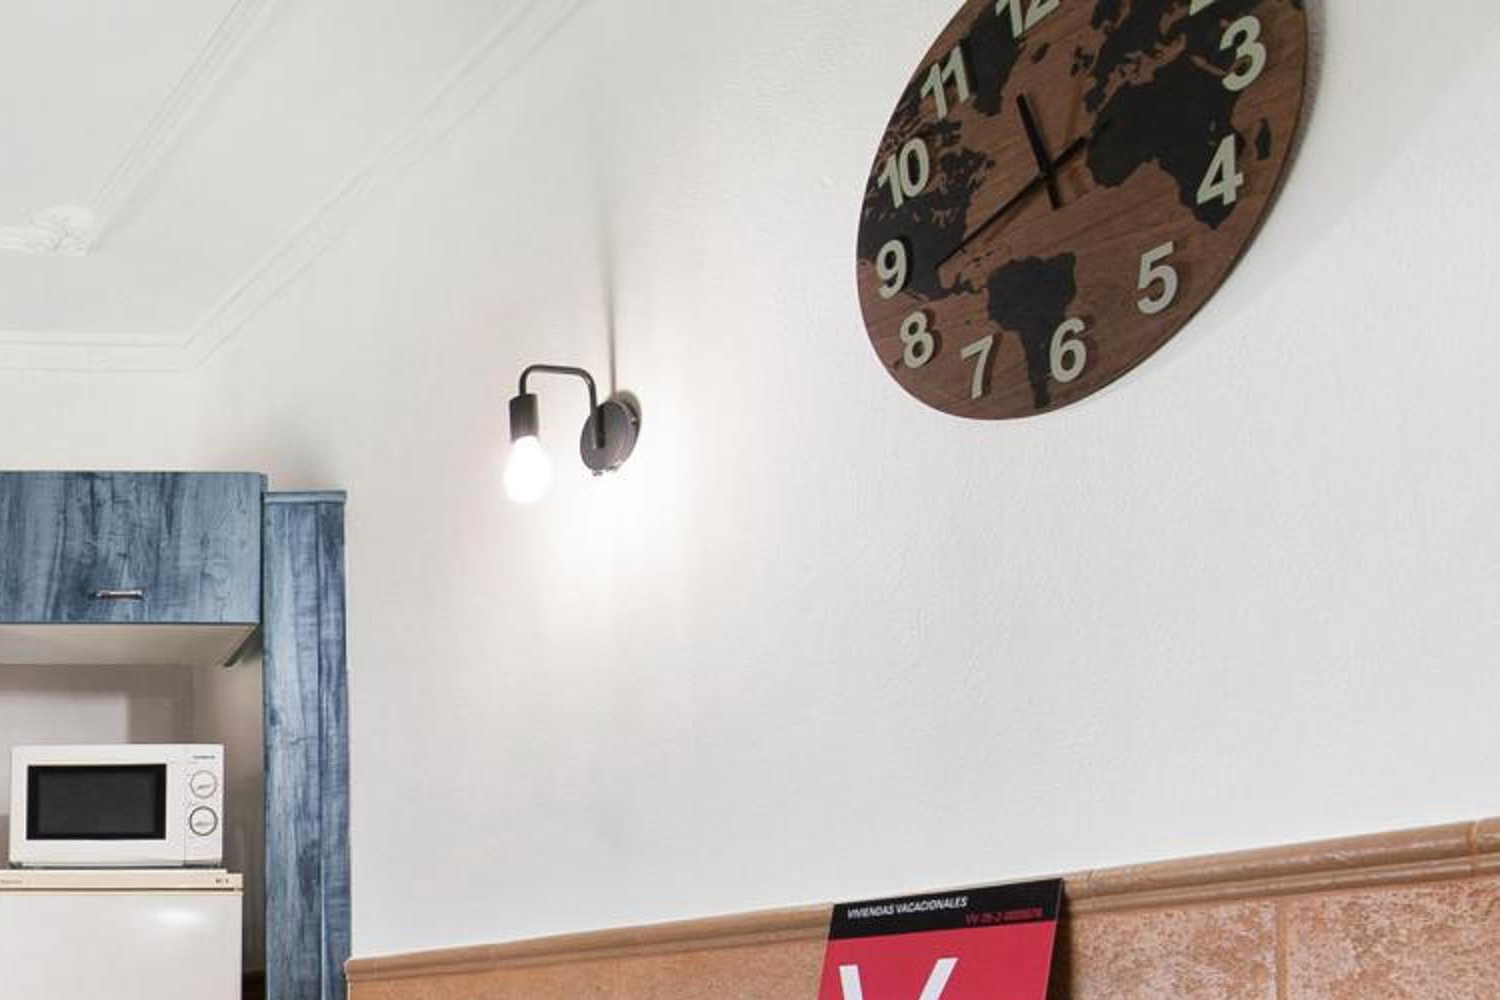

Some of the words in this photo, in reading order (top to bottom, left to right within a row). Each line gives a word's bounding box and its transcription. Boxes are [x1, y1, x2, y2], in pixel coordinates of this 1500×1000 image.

[921, 46, 969, 119] 11
[1219, 15, 1267, 91] 3
[878, 138, 930, 208] 10
[1196, 135, 1243, 205] 4
[875, 239, 908, 299] 9
[1137, 241, 1178, 314] 5
[901, 312, 935, 369] 8
[961, 335, 993, 399] 7
[1050, 318, 1087, 383] 6
[847, 905, 894, 919] VIVIENDAS
[897, 896, 968, 913] VACACIONALES
